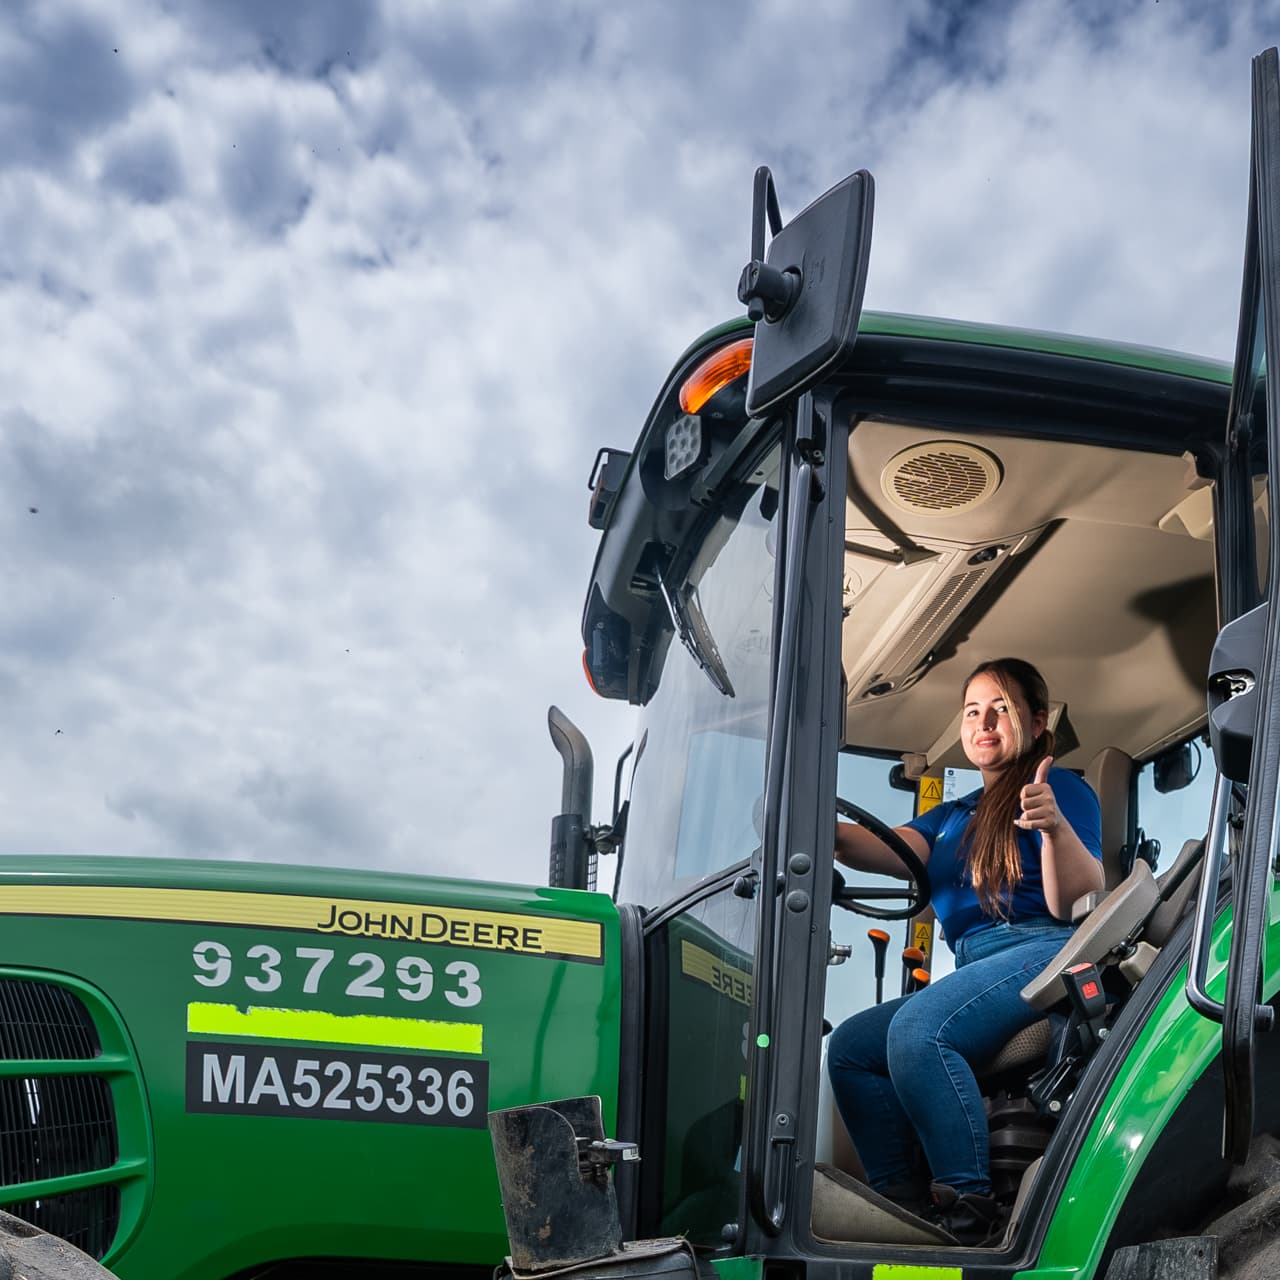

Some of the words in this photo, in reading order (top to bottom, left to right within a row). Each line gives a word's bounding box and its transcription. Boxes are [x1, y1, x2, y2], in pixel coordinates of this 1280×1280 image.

[317, 905, 414, 937] JOHN
[421, 912, 543, 950] DEERE
[192, 940, 484, 1008] 937293
[202, 1053, 475, 1118] MA525336
